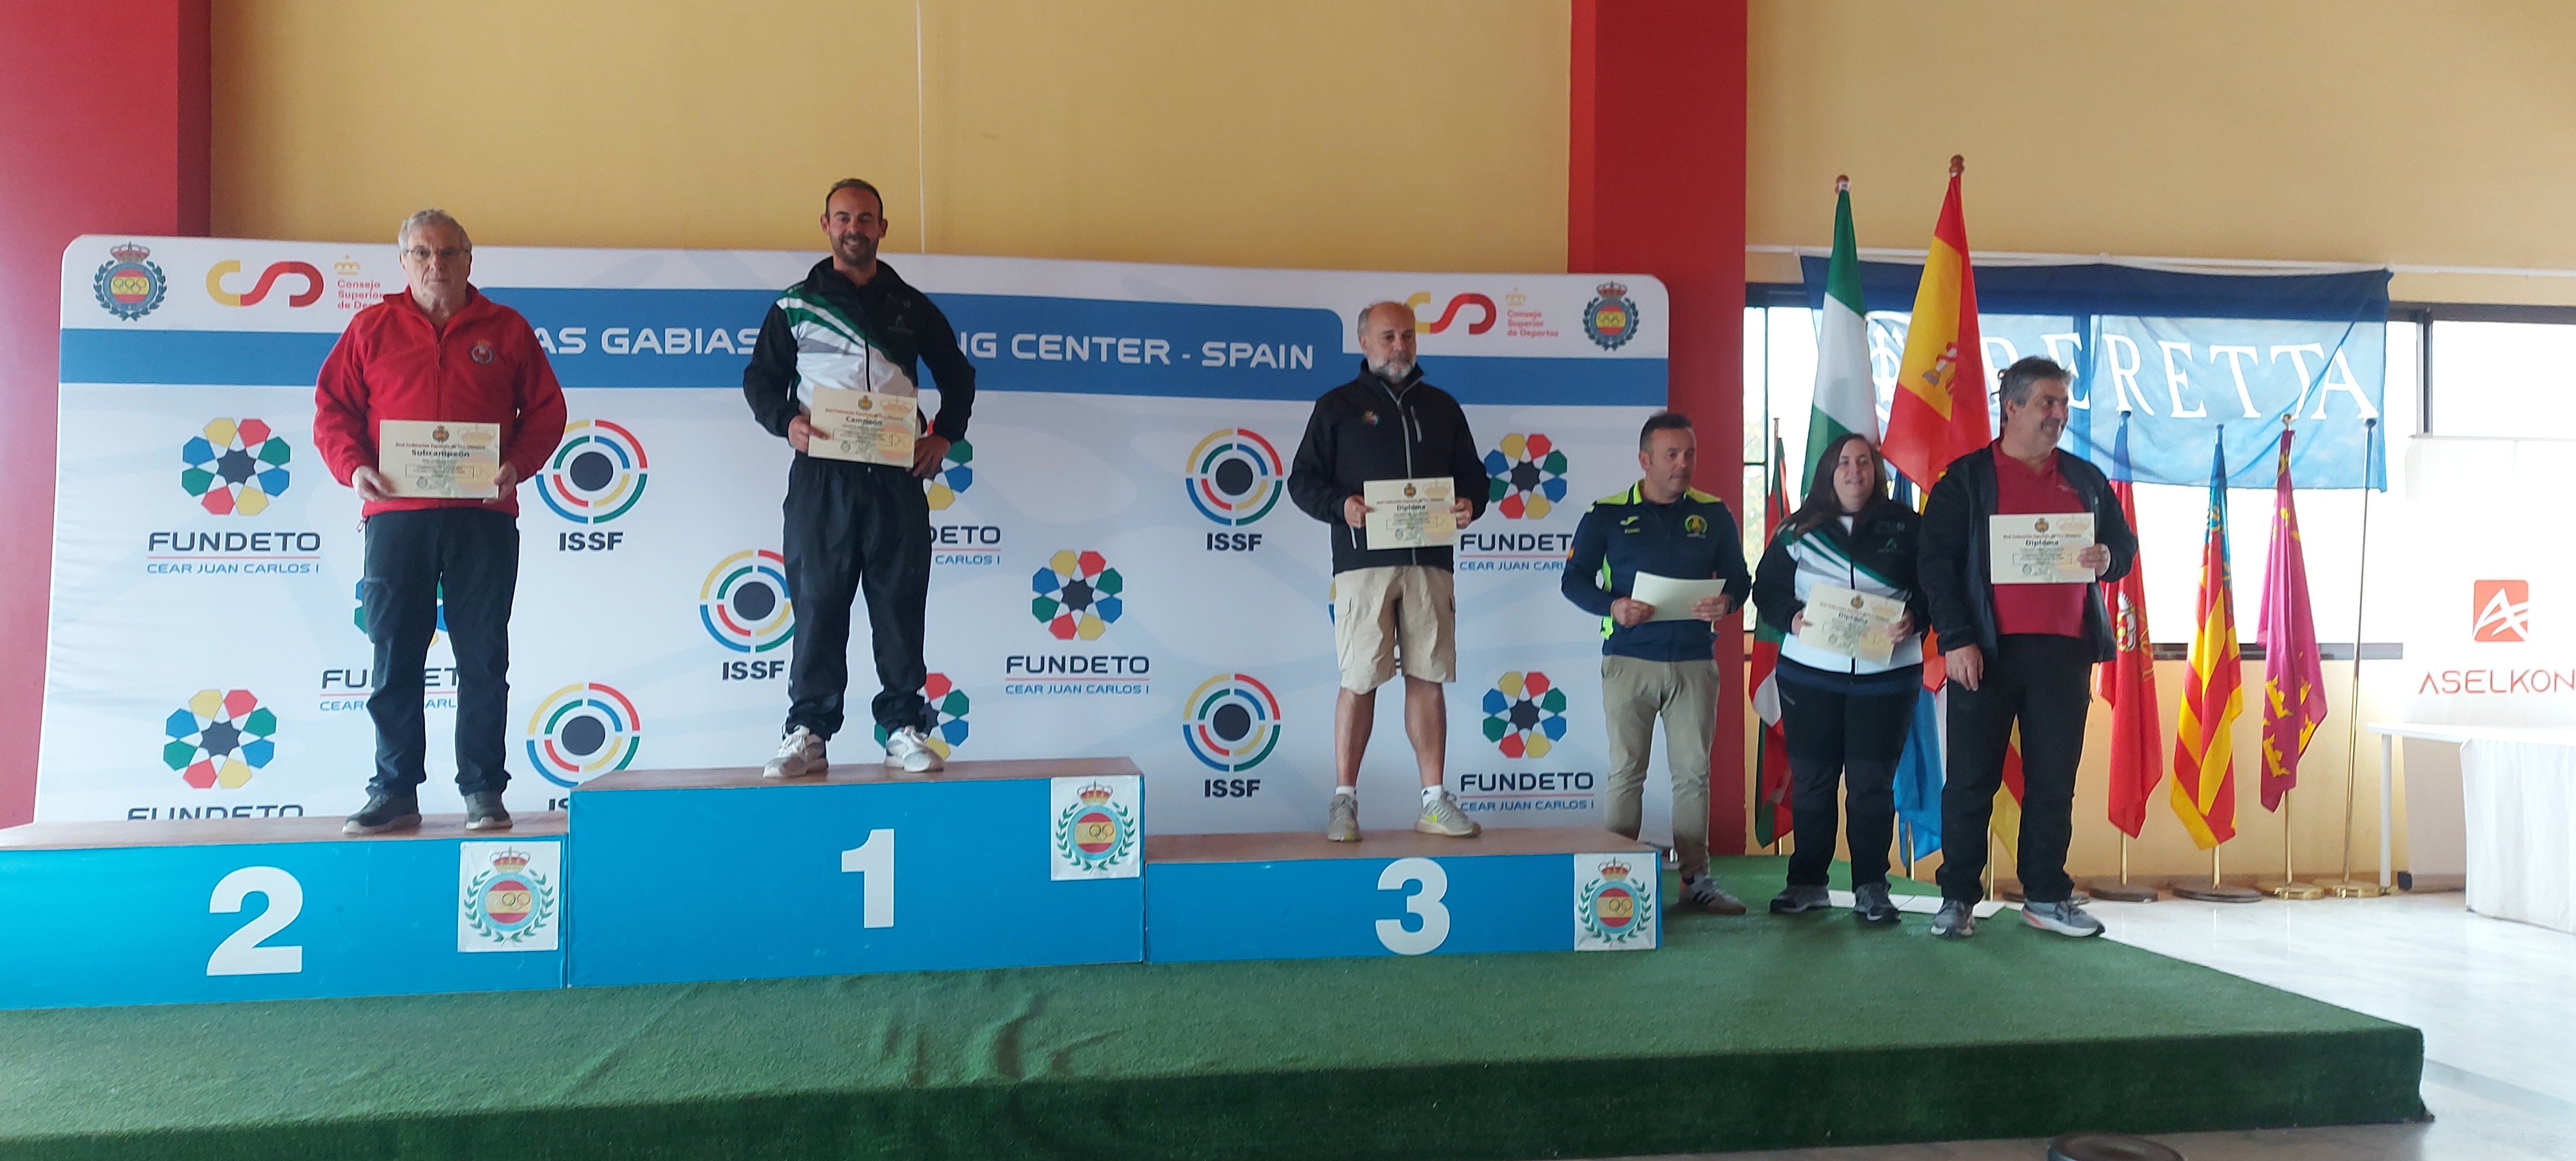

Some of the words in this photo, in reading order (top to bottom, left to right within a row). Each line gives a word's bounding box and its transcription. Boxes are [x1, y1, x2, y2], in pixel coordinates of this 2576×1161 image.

[338, 279, 380, 289] Consejo
[534, 328, 587, 354] AS
[601, 328, 760, 355] GABIAS
[1011, 334, 1170, 365] CENTER
[1202, 341, 1313, 370] SPAIN
[148, 532, 321, 552] FUNDETO
[559, 532, 623, 551] ISSF
[1207, 533, 1262, 551] ISSF
[1460, 533, 1572, 551] FUNDET
[147, 564, 192, 574] CEAR
[197, 564, 238, 574] JUAN
[244, 564, 310, 574] CARLOS
[935, 555, 992, 565] CARLOS
[1460, 561, 1494, 570] CEAR
[1498, 561, 1529, 570] JUAN
[722, 661, 785, 680] ISSF
[1006, 655, 1149, 674] FUNDETO
[1006, 685, 1043, 694] CEAR
[1048, 685, 1081, 694] JUAN
[1086, 685, 1141, 694] CARLOS
[2418, 669, 2575, 695] ASELKON
[320, 700, 364, 711] CEAR
[1204, 779, 1260, 797] ISSF
[1461, 772, 1594, 792] FUNDETO
[1461, 801, 1496, 812] CEAR
[1500, 801, 1531, 811] JUAN
[1535, 800, 1587, 811] CARLOS
[842, 828, 895, 928] 1
[1375, 857, 1450, 955] 3
[207, 866, 303, 976] 2
